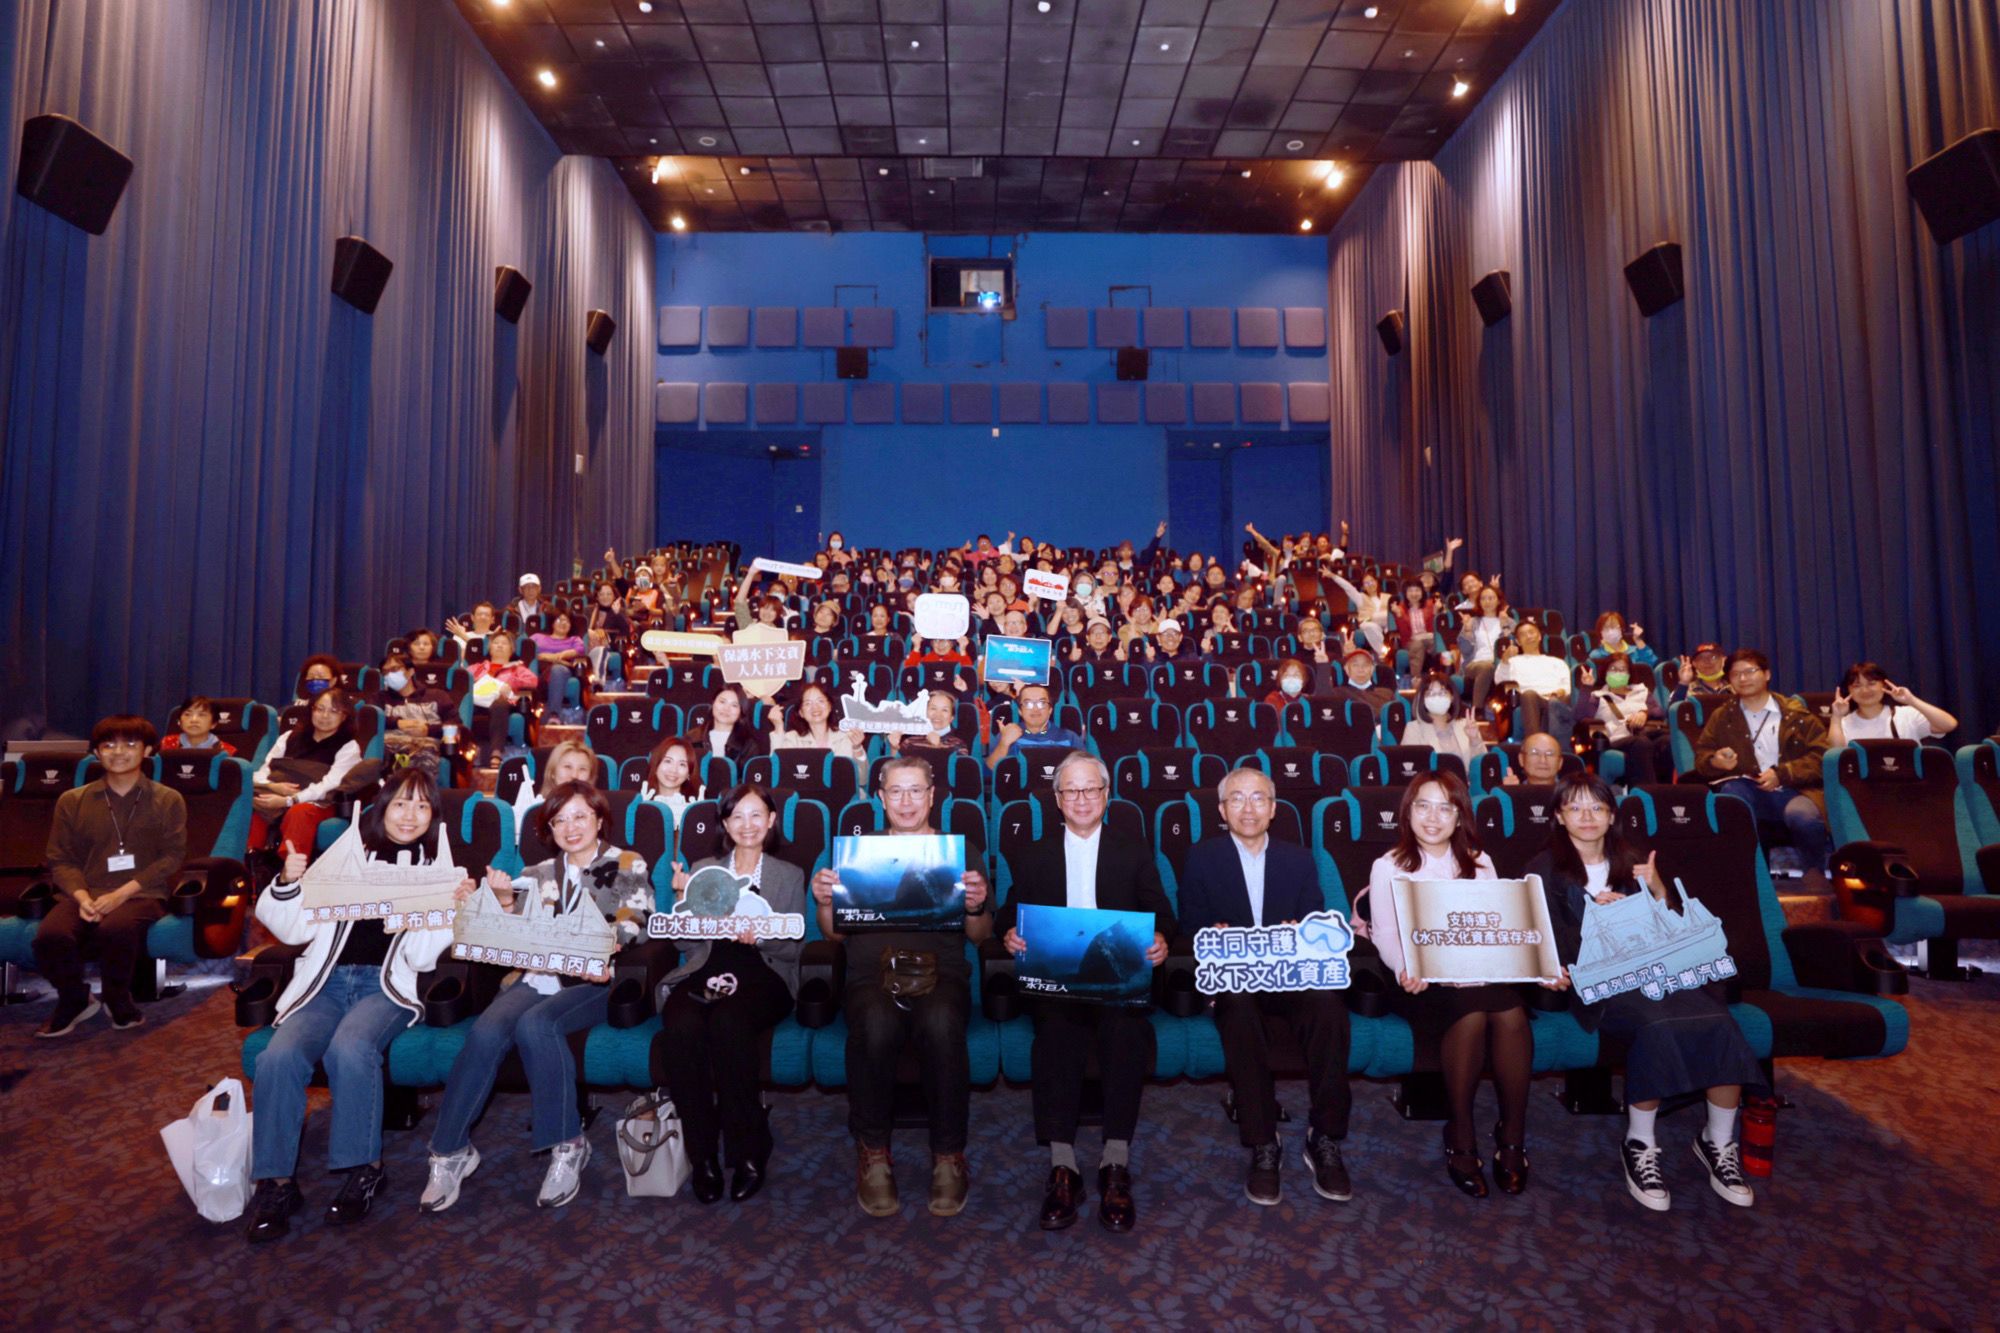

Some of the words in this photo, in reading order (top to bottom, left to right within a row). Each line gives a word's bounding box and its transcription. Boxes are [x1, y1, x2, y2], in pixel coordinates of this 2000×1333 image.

[723, 646, 799, 662] 保護水下文資
[738, 662, 787, 677] 人人有責
[508, 773, 518, 781] 11
[630, 773, 640, 782] 10
[754, 772, 762, 782] 9
[1004, 773, 1011, 782] 7
[1125, 772, 1133, 782] 6
[696, 822, 706, 834] 9
[853, 825, 862, 836] 8
[1012, 823, 1021, 834] 7
[1172, 823, 1181, 835] 6
[1333, 821, 1342, 832] 5
[844, 912, 886, 921] 水下巨人
[1448, 912, 1501, 928] 支持遵守
[651, 916, 801, 934] 出水遺物交給文資局
[1199, 931, 1297, 959] 共同守護
[1199, 958, 1348, 990] 水下文化資產
[1025, 982, 1068, 992] 水下巨人
